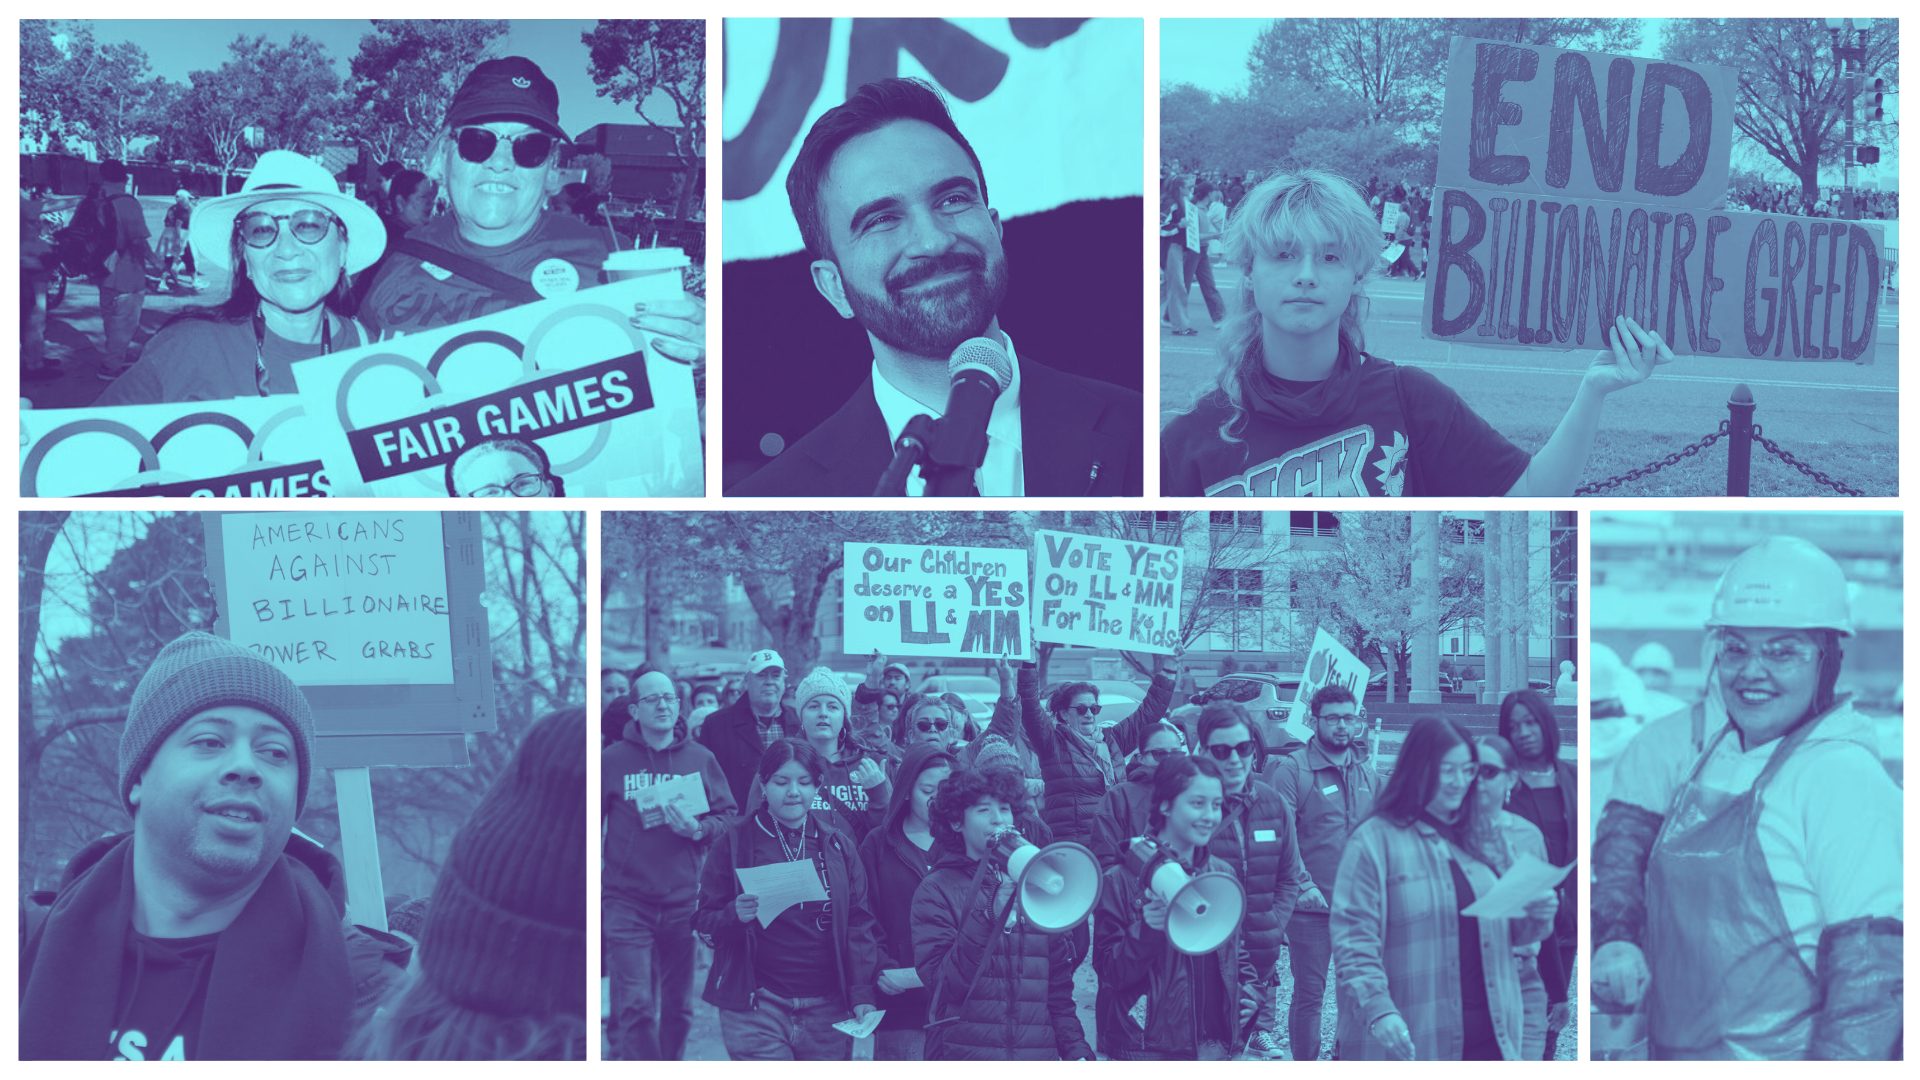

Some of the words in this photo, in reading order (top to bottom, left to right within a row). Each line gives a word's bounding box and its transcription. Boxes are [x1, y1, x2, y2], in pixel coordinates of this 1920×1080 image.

[1470, 43, 1713, 196] END
[1432, 190, 1732, 353] BILLIONAIRE
[1743, 219, 1879, 361] GREED
[373, 416, 466, 467] FAIR
[476, 370, 634, 436] GAMES
[253, 519, 404, 550] AMERICANS
[269, 554, 396, 581] AGAINST
[862, 547, 912, 572] Our
[920, 549, 1006, 577] Children
[1125, 544, 1178, 581] YES
[854, 572, 932, 599] deserve
[943, 584, 957, 599] a
[964, 575, 1024, 607] YES
[1045, 573, 1078, 596] On
[1089, 574, 1117, 600] LL
[1121, 582, 1131, 597] &
[1134, 579, 1174, 608] MM
[253, 594, 449, 623] BILLIONAIRE
[1042, 599, 1081, 630] For
[1083, 600, 1122, 635] The
[863, 604, 894, 622] on
[899, 600, 950, 644] LL
[945, 608, 957, 624] &
[960, 609, 1022, 655] MM
[362, 641, 435, 660] GRABS
